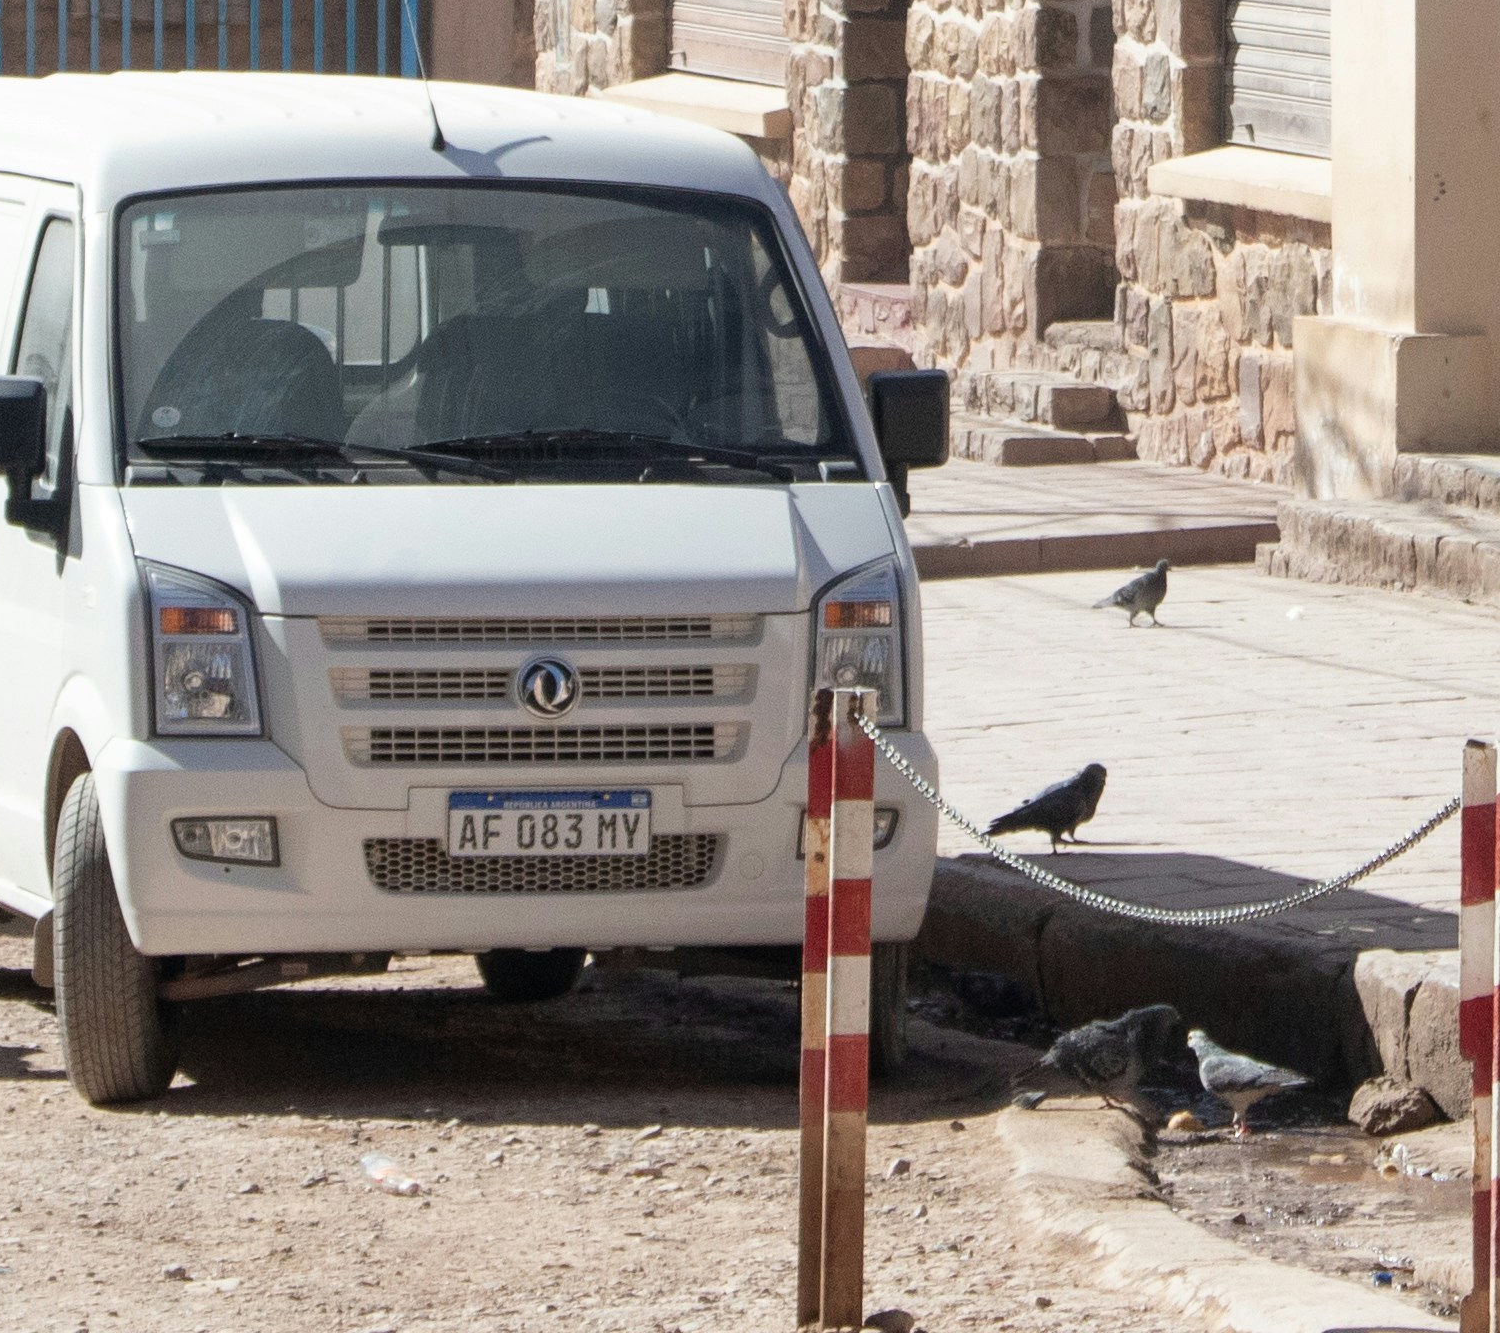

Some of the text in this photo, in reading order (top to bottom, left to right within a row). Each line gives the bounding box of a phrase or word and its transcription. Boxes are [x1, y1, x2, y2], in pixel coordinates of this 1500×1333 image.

[459, 812, 641, 851] AF 083 MY
